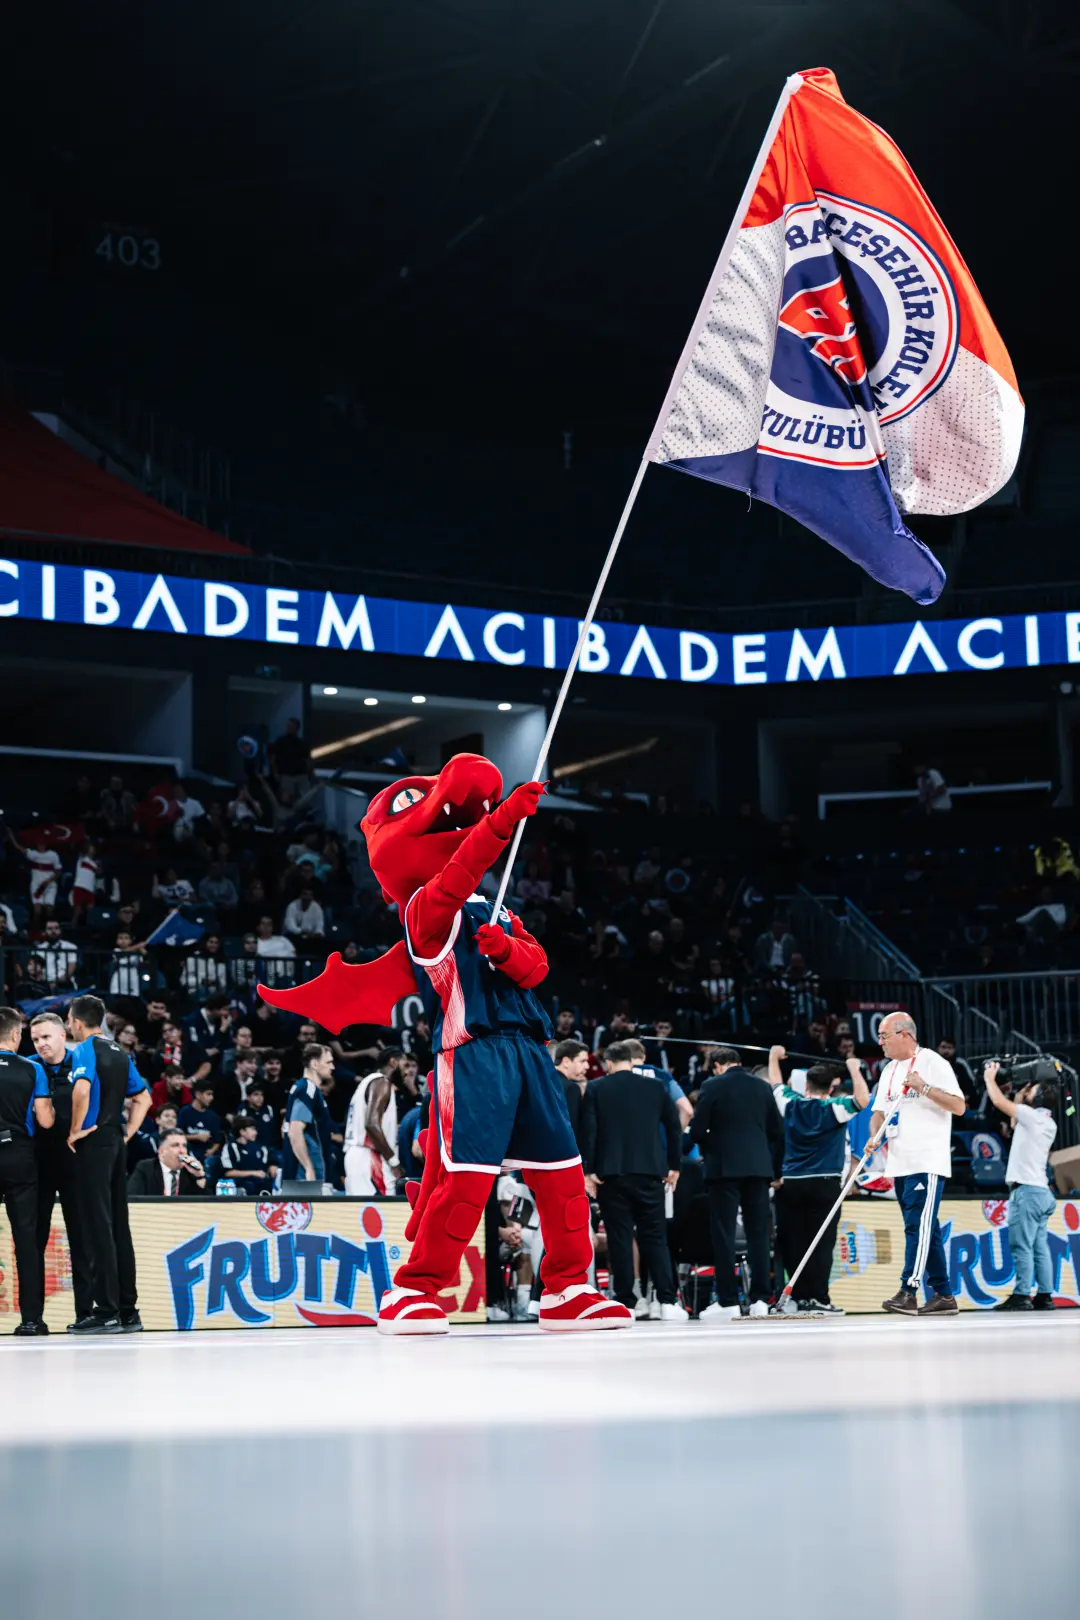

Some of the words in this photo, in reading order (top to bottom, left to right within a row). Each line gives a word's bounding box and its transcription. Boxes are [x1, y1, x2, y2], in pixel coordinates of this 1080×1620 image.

[95, 233, 162, 270] 403
[785, 207, 937, 320] BAÇEŞEHİR
[423, 604, 847, 685] ACIBADEM
